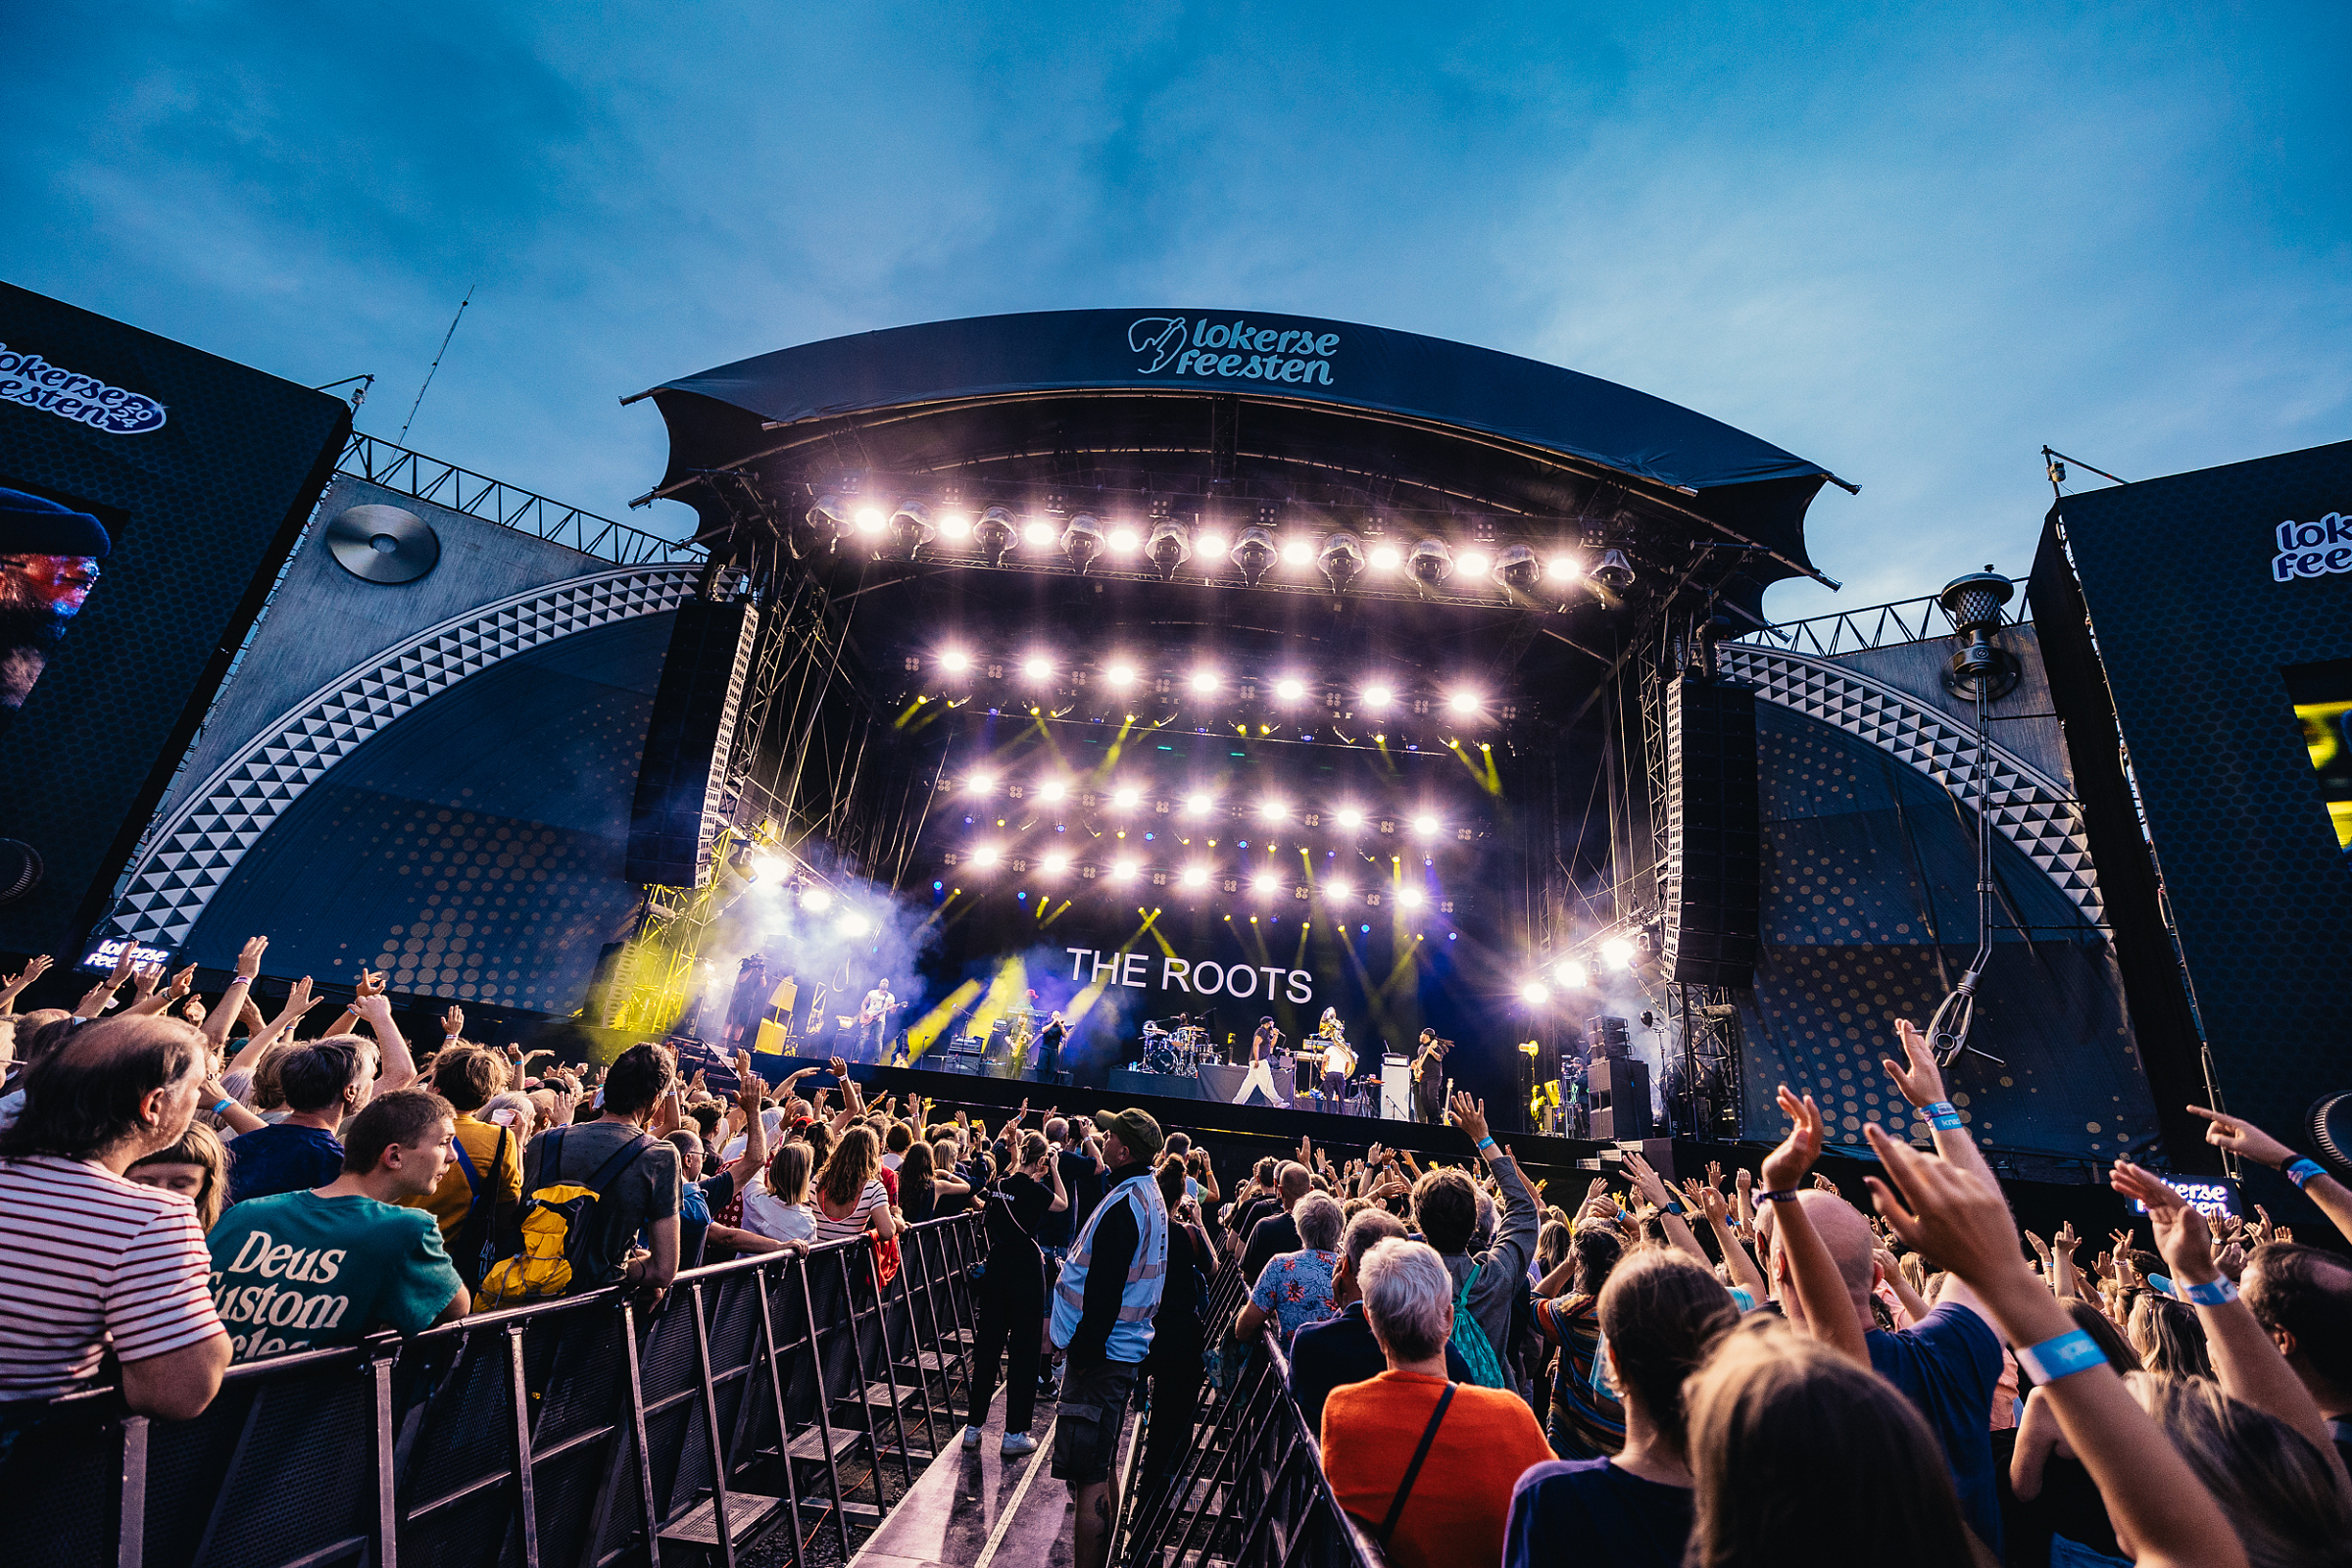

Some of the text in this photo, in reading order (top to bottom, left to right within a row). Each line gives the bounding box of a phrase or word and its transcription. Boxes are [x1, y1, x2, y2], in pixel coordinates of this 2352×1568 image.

[1192, 318, 1341, 357] lokerse
[0, 345, 125, 406] okerse
[1176, 349, 1335, 386] feesten
[1066, 947, 1312, 1004] THE ROOTS
[227, 1230, 347, 1284] Deus
